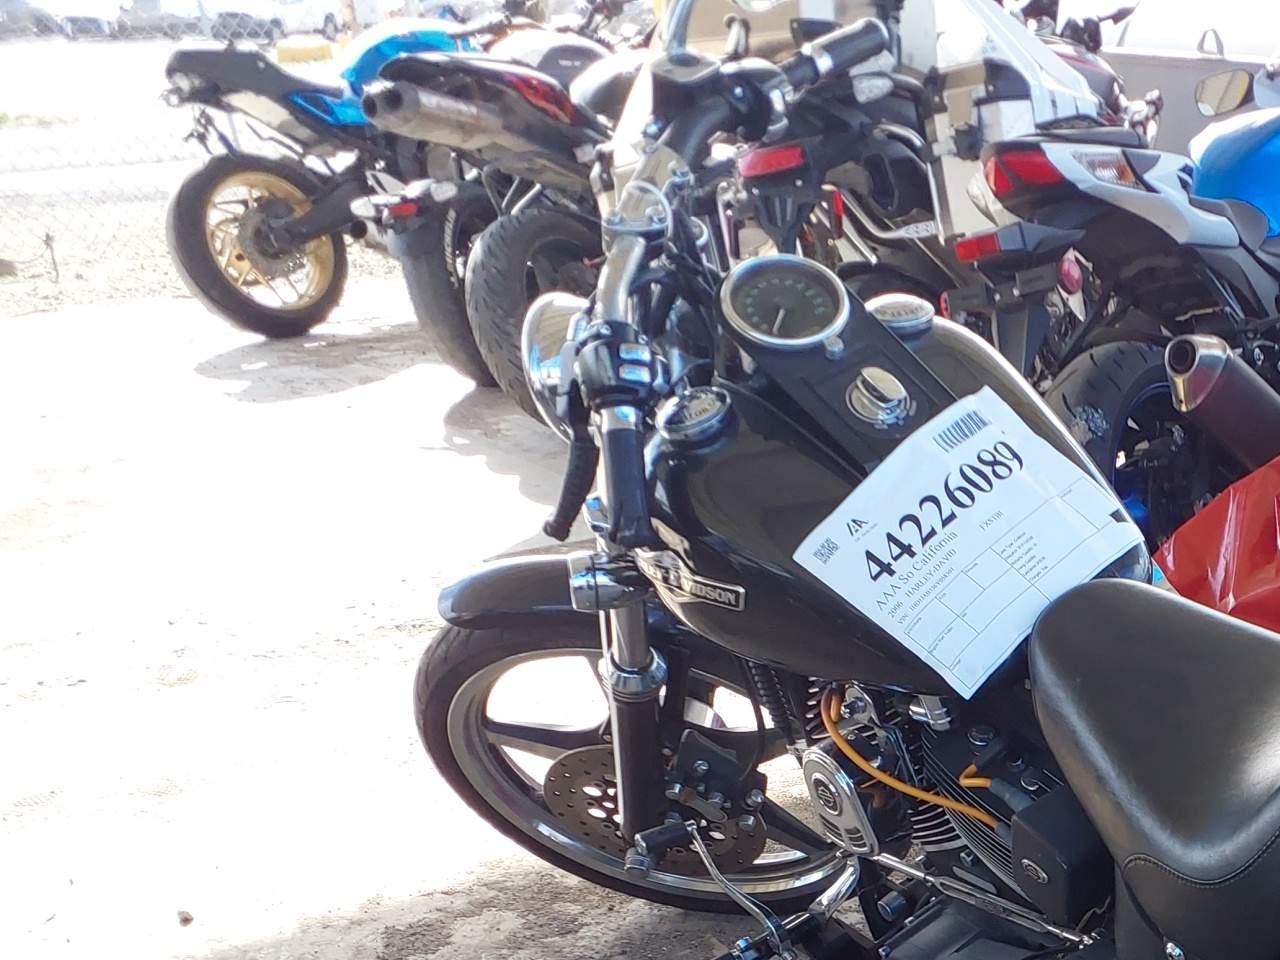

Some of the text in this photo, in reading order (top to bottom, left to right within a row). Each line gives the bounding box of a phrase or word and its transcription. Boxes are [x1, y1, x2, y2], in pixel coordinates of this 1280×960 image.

[864, 441, 1024, 582] 44226089
[875, 583, 902, 611] AAA
[898, 571, 915, 585] So
[912, 530, 959, 571] California
[904, 548, 957, 599] HARLEY-DAVID
